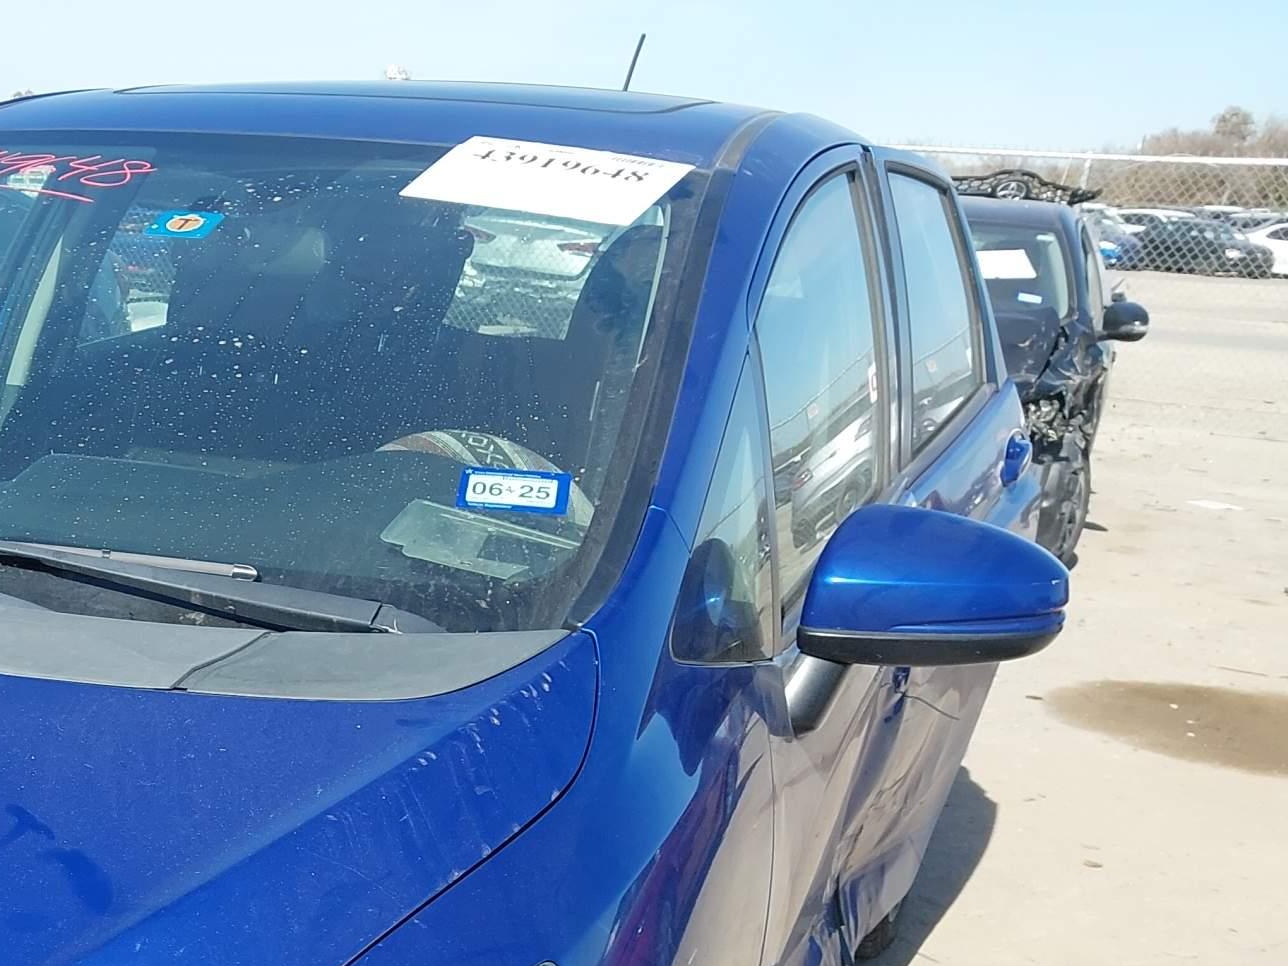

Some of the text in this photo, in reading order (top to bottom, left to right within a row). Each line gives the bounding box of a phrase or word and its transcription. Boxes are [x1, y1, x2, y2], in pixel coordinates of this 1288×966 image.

[473, 149, 649, 182] 43919648
[472, 481, 551, 500] 06 25
